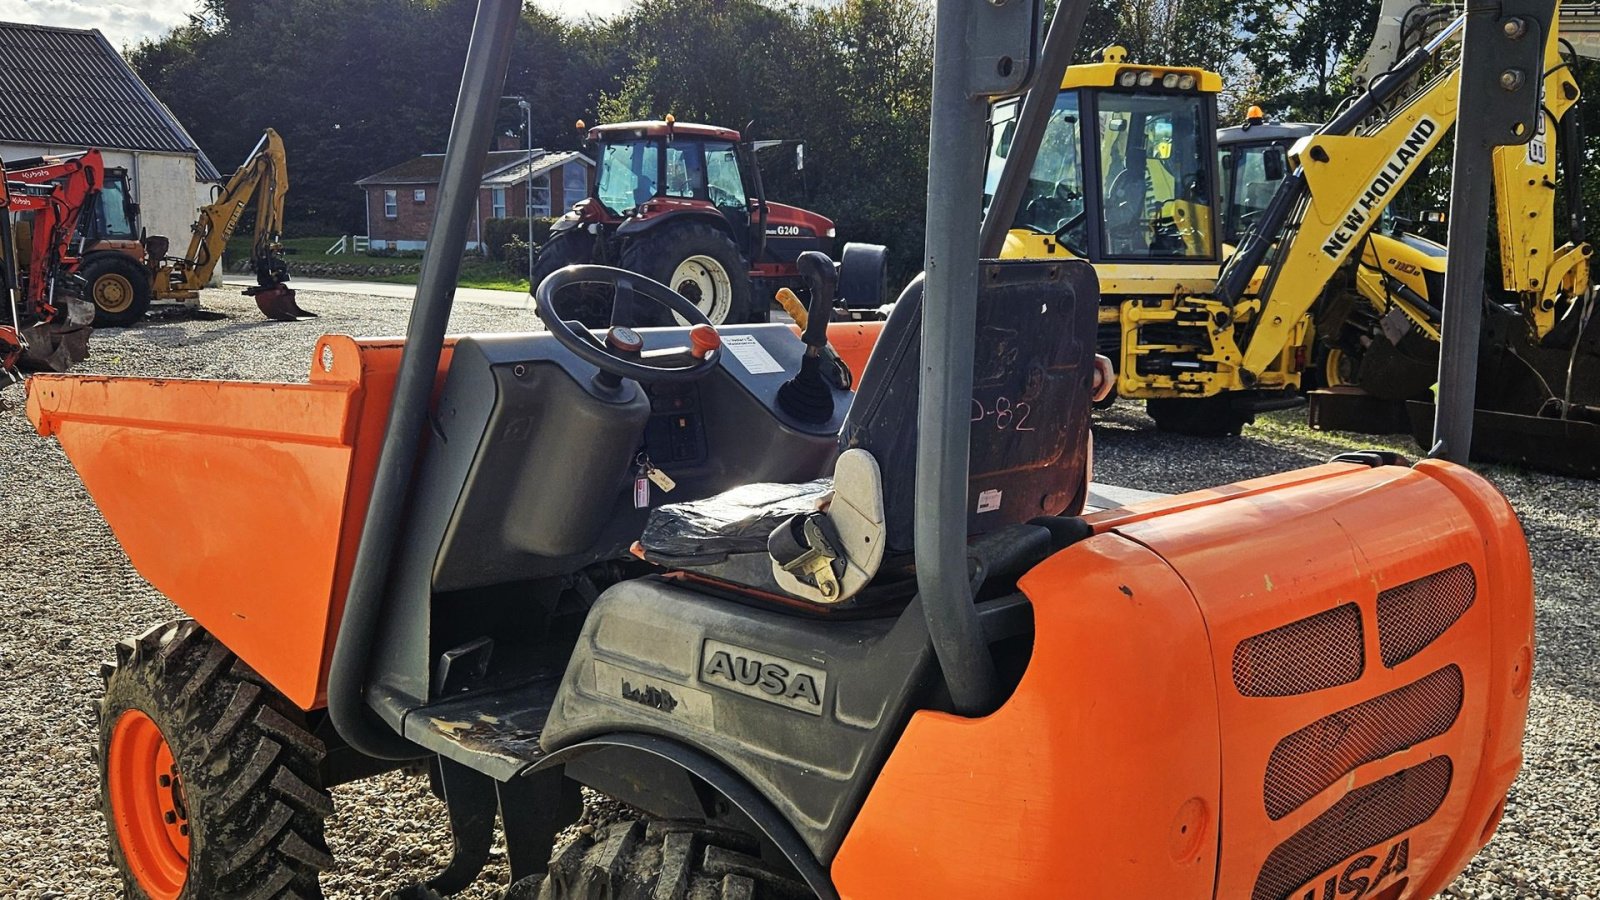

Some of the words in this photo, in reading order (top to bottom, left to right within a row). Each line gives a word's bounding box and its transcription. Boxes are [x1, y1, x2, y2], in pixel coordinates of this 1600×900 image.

[21, 170, 50, 178] Kubota
[1322, 208, 1365, 259] NEW
[1359, 118, 1436, 211] HOLLAND
[777, 225, 799, 235] G240
[704, 650, 821, 706] AUSA
